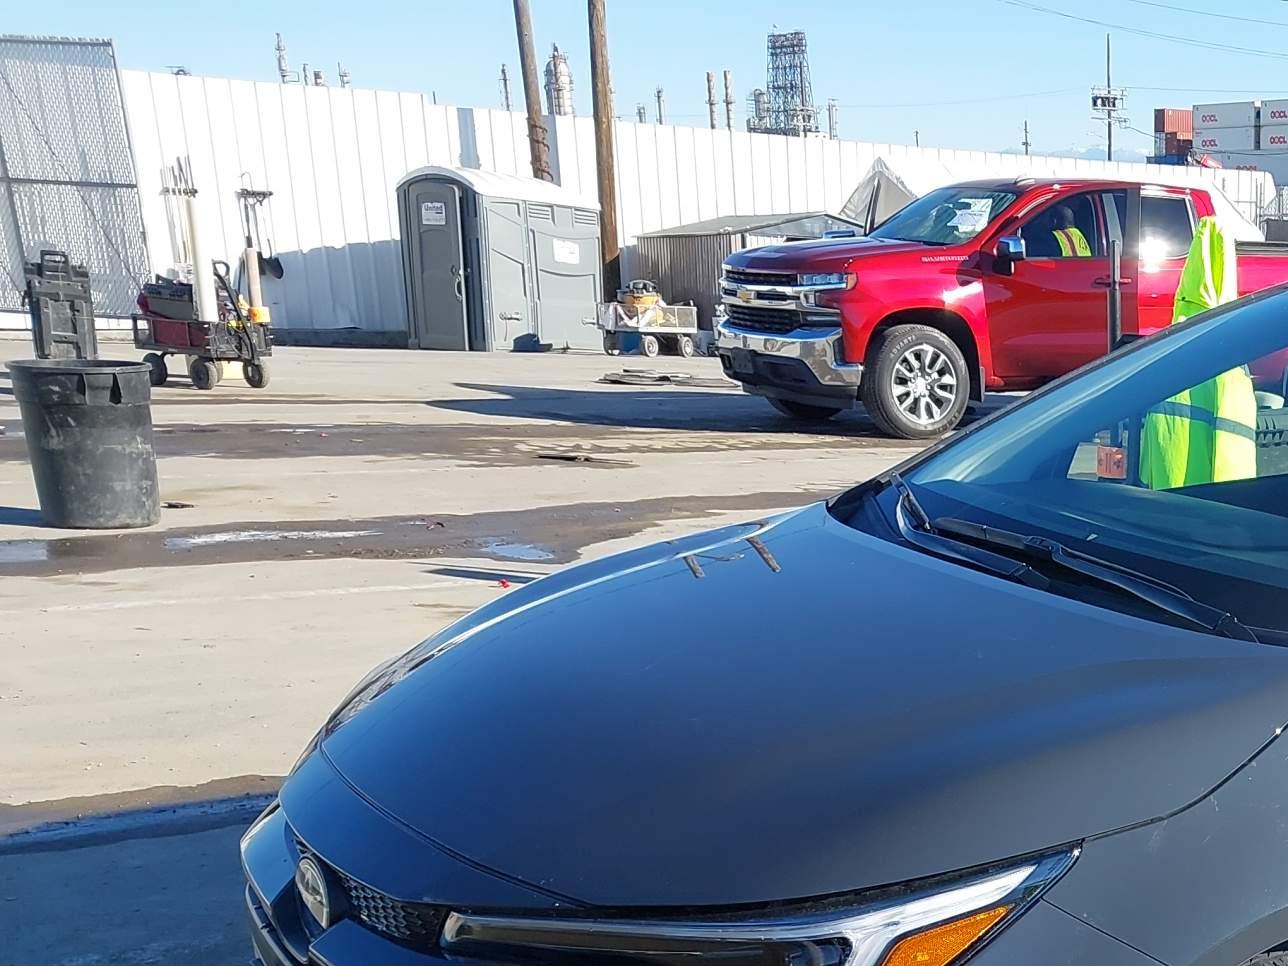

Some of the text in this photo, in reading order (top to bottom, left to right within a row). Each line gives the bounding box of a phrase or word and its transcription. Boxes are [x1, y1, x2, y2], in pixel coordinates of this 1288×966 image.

[1201, 114, 1218, 123] OOCL
[1270, 110, 1288, 119] OOCL
[1201, 139, 1218, 147] OOCL
[1269, 135, 1287, 144] OOCL
